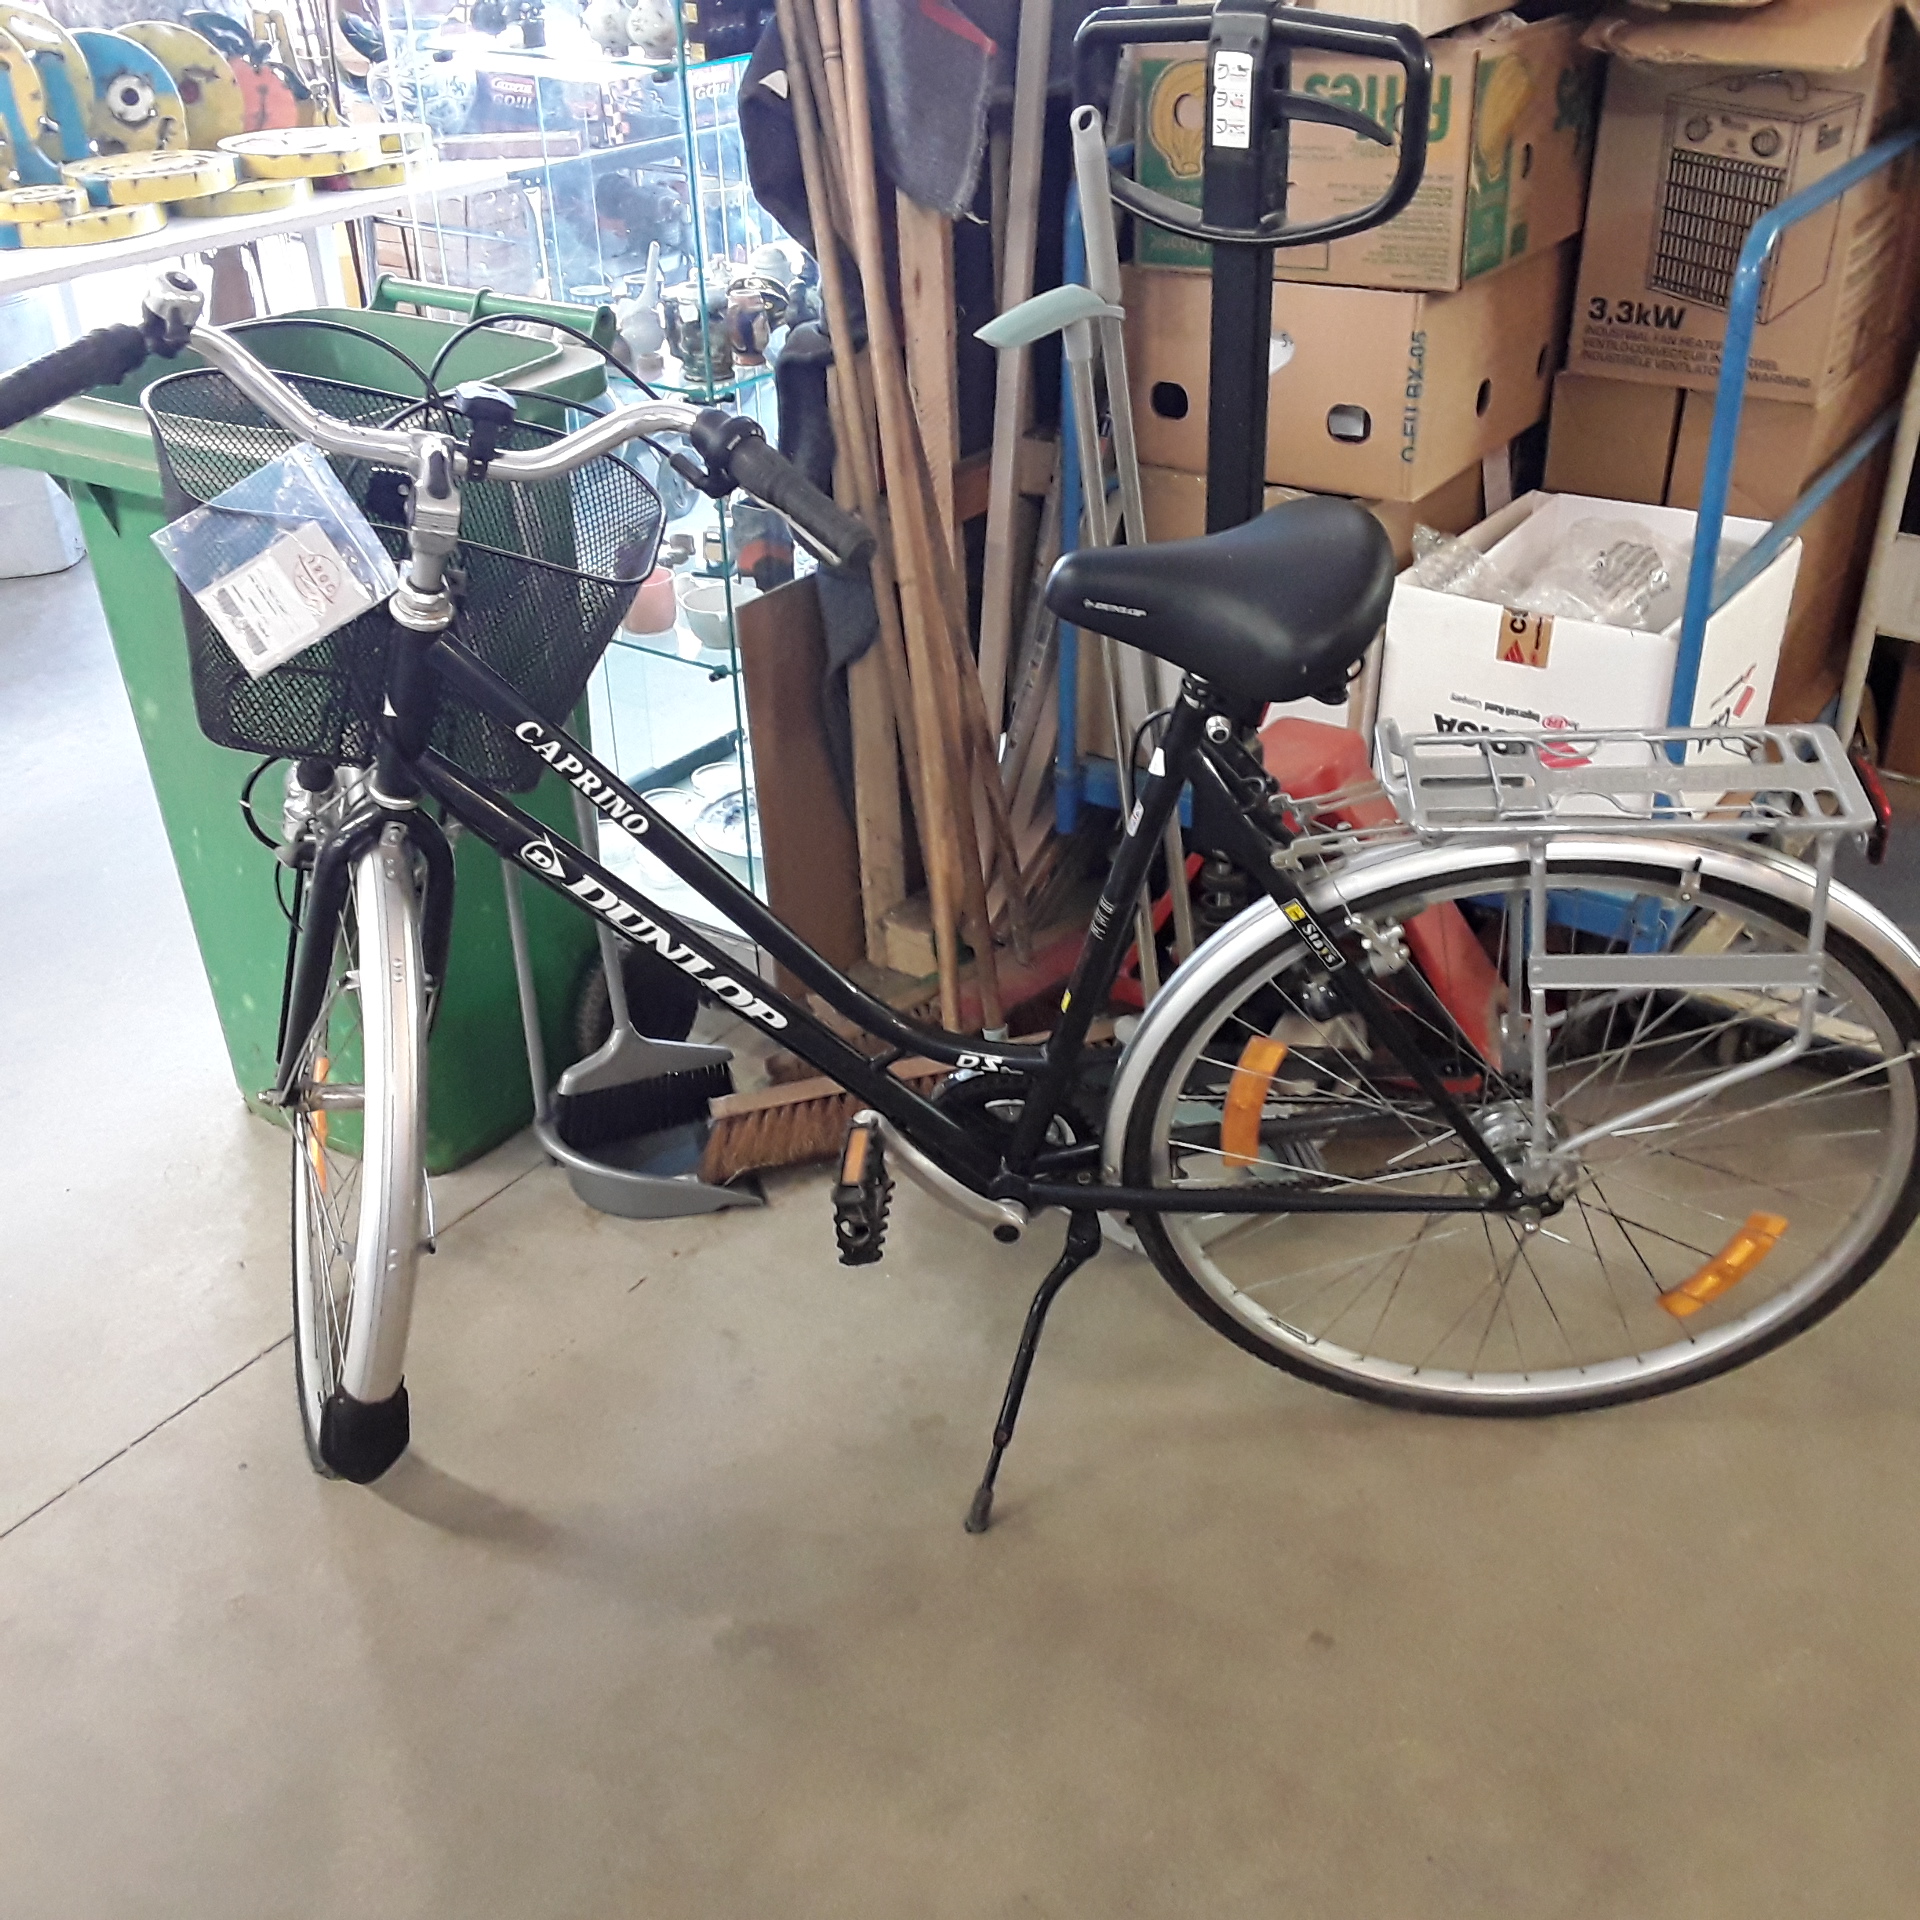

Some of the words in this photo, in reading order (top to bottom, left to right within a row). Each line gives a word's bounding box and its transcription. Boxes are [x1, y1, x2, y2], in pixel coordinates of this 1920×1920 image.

[1588, 296, 1687, 331] 3,3kW
[513, 720, 650, 837] CAPRINO
[563, 873, 789, 1031] DUNLOP
[1302, 922, 1336, 967] Stays
